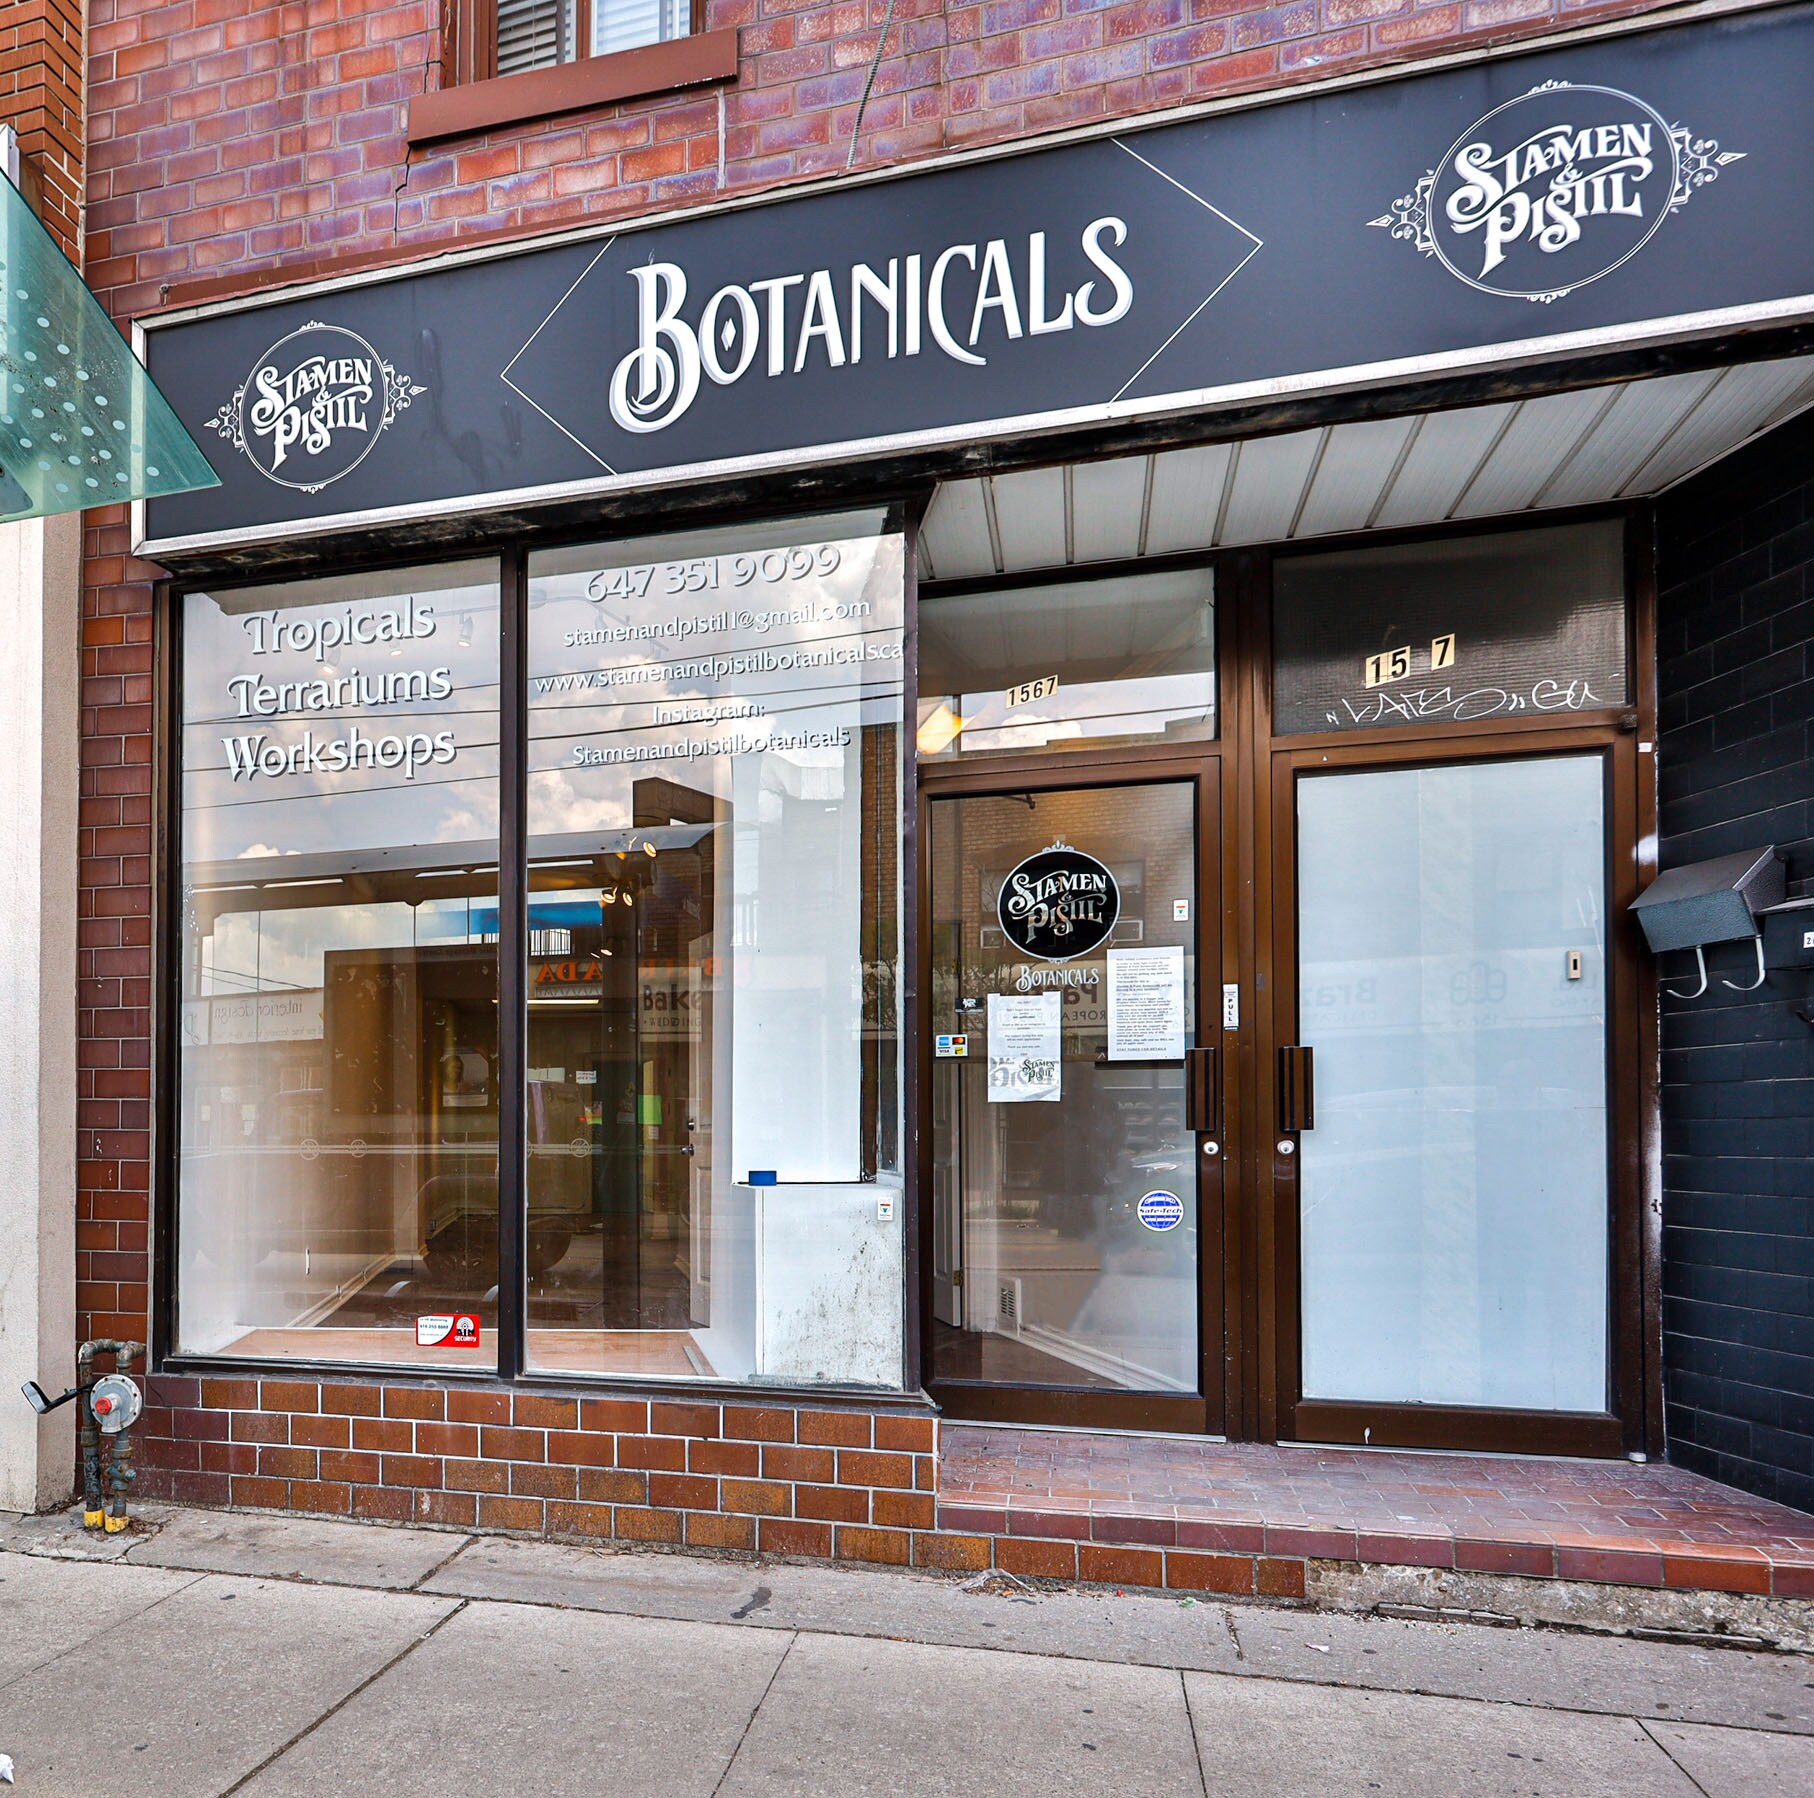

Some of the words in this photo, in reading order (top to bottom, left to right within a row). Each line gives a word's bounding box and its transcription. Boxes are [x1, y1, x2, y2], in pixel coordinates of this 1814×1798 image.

[1446, 123, 1652, 223] STAMEN
[1450, 157, 1653, 280] PISTIL
[609, 216, 1133, 433] BOTANICALS
[251, 356, 372, 427] STAMEN
[254, 384, 373, 472] PISTIL
[585, 565, 656, 602] 647
[664, 558, 719, 595] 351
[734, 544, 841, 587] 9099
[243, 595, 436, 661] Tropicals
[227, 667, 453, 718] Terrariums
[652, 700, 766, 726] Instagram:
[1008, 676, 1057, 706] 1567
[221, 726, 457, 782] Workshops
[571, 725, 851, 765] Stamenandpistilbotanicals
[1008, 870, 1107, 914] STAMEN
[1012, 893, 1107, 944] PISTIL
[1016, 965, 1099, 992] BOTANICALS
